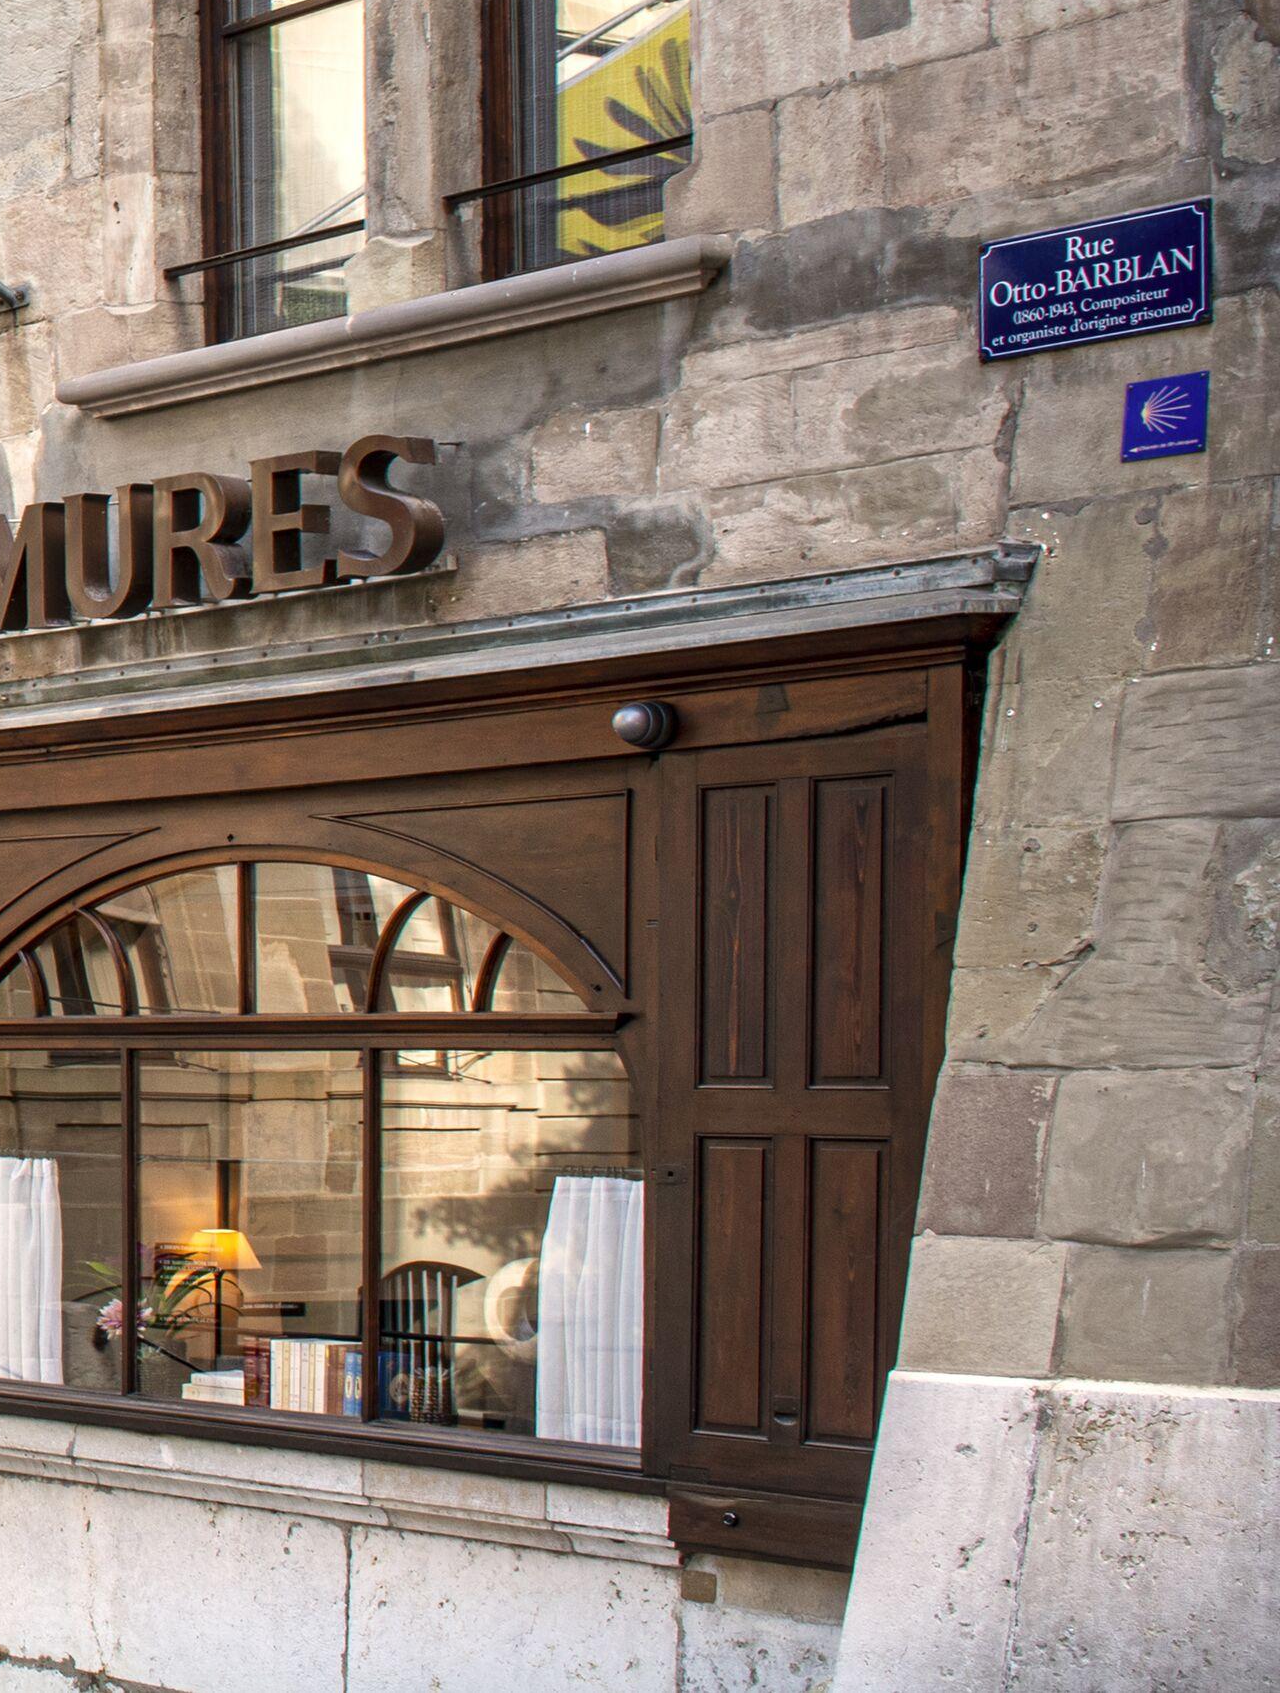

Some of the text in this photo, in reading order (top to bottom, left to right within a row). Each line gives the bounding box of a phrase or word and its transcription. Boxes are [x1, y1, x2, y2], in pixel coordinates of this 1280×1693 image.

[1064, 236, 1114, 262] Rue
[989, 245, 1195, 307] Otto-BARBLAN
[991, 298, 1194, 347] et organiste d'origine grisonne)
[1013, 286, 1169, 325] (1860-1943, Compositeur
